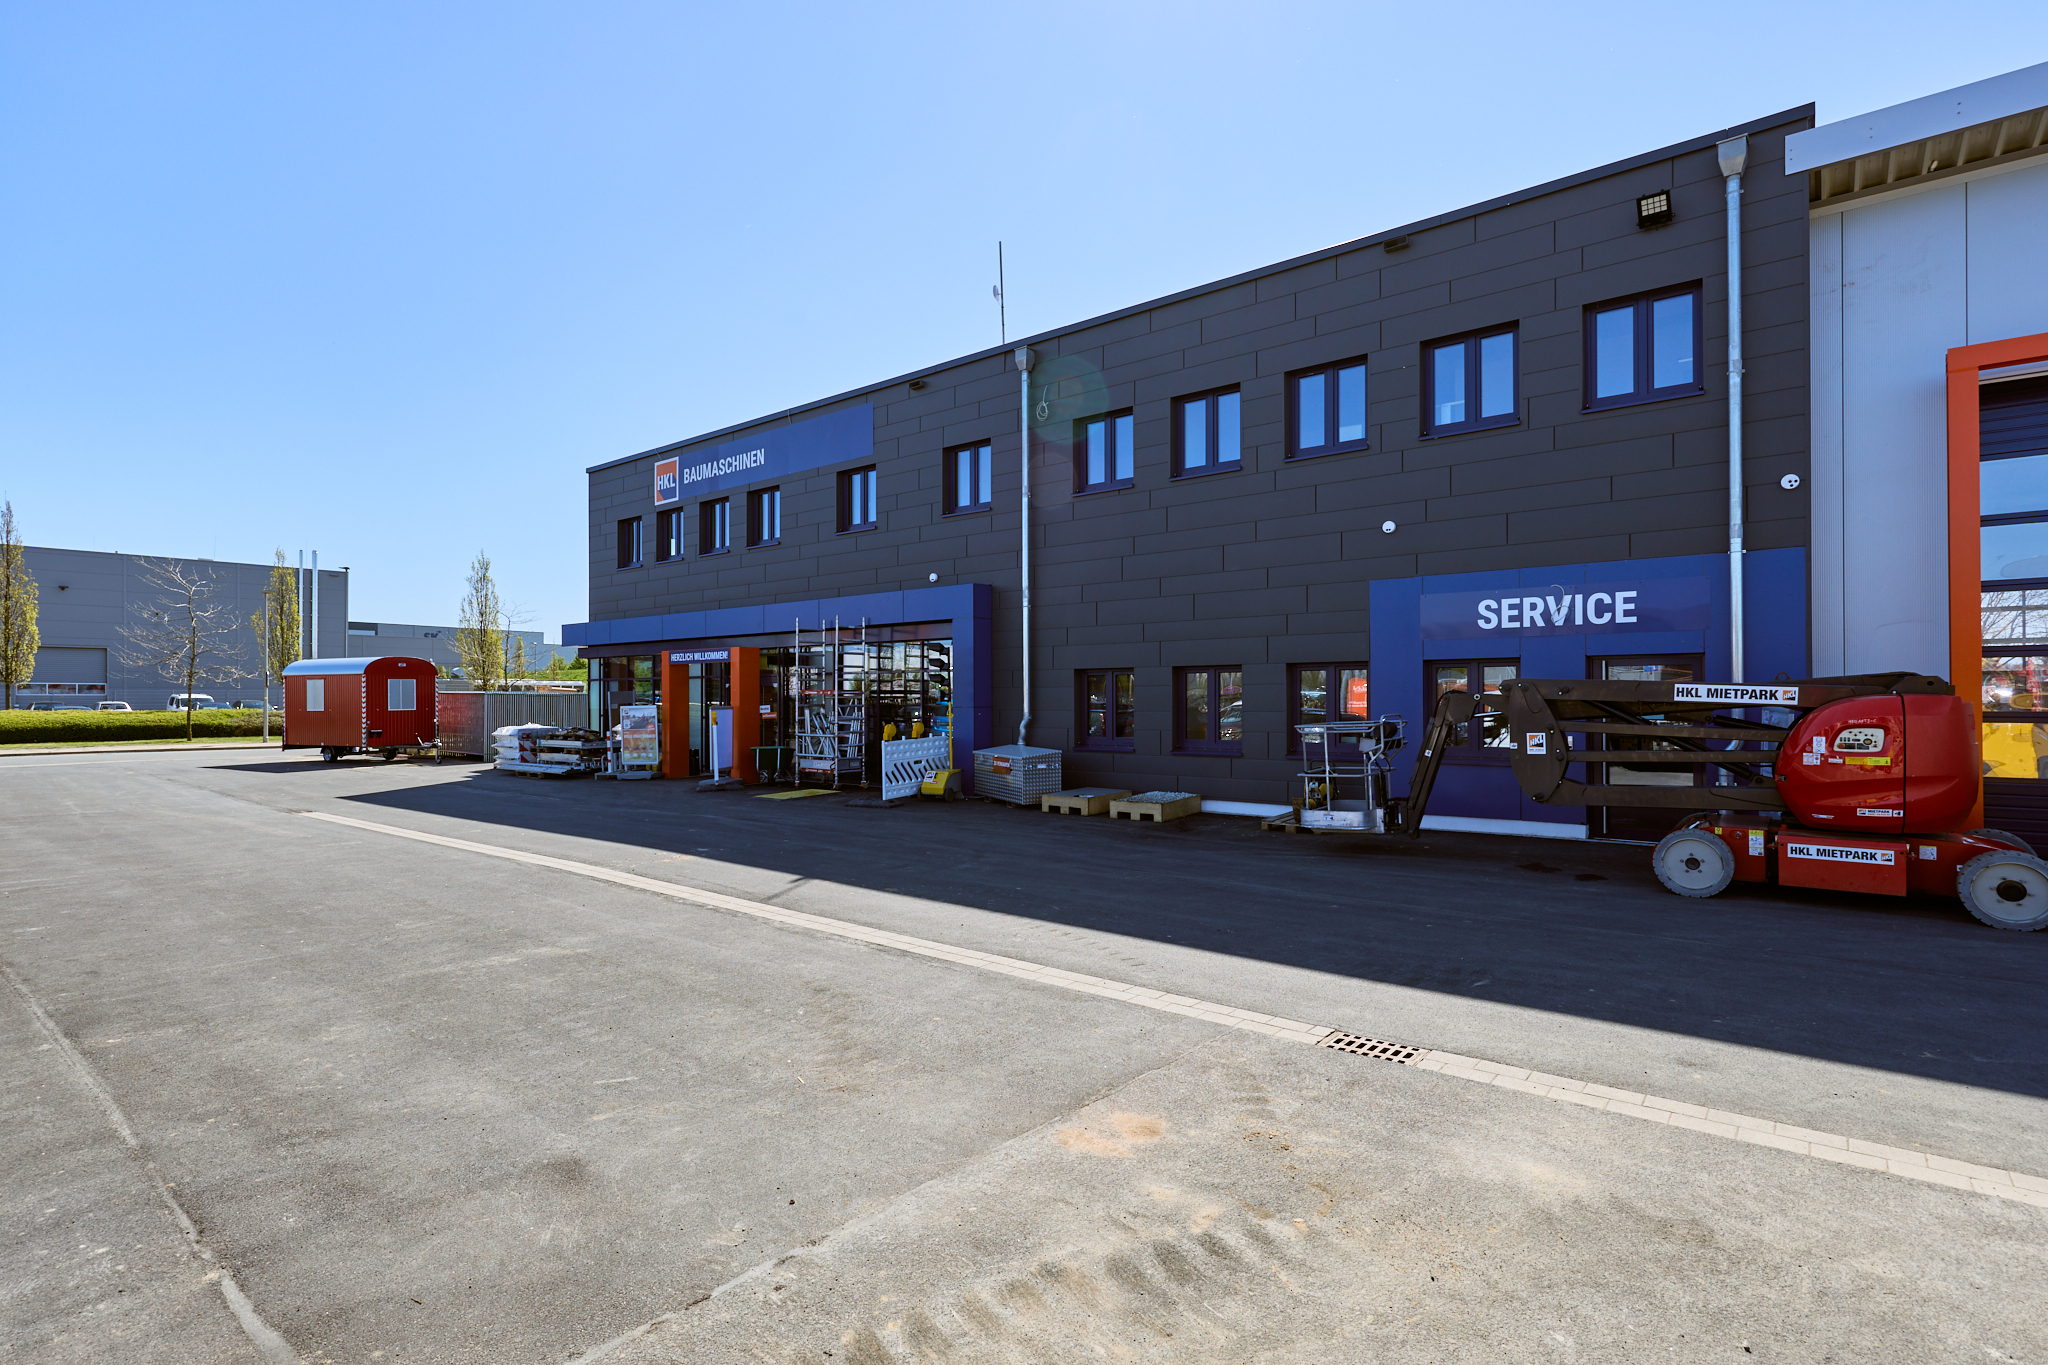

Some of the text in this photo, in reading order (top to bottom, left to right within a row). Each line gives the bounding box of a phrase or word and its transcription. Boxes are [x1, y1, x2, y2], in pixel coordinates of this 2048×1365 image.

[657, 448, 765, 491] HKL BAUMASCHINEN
[1476, 590, 1638, 630] SERVICE
[670, 651, 729, 662] HERZLICH WILLKOMMEN!
[1676, 687, 1779, 701] HKL MIETPARK
[1783, 690, 1797, 700] HKL
[1530, 734, 1544, 746] HKL
[1790, 846, 1878, 862] HKL MIETPARK
